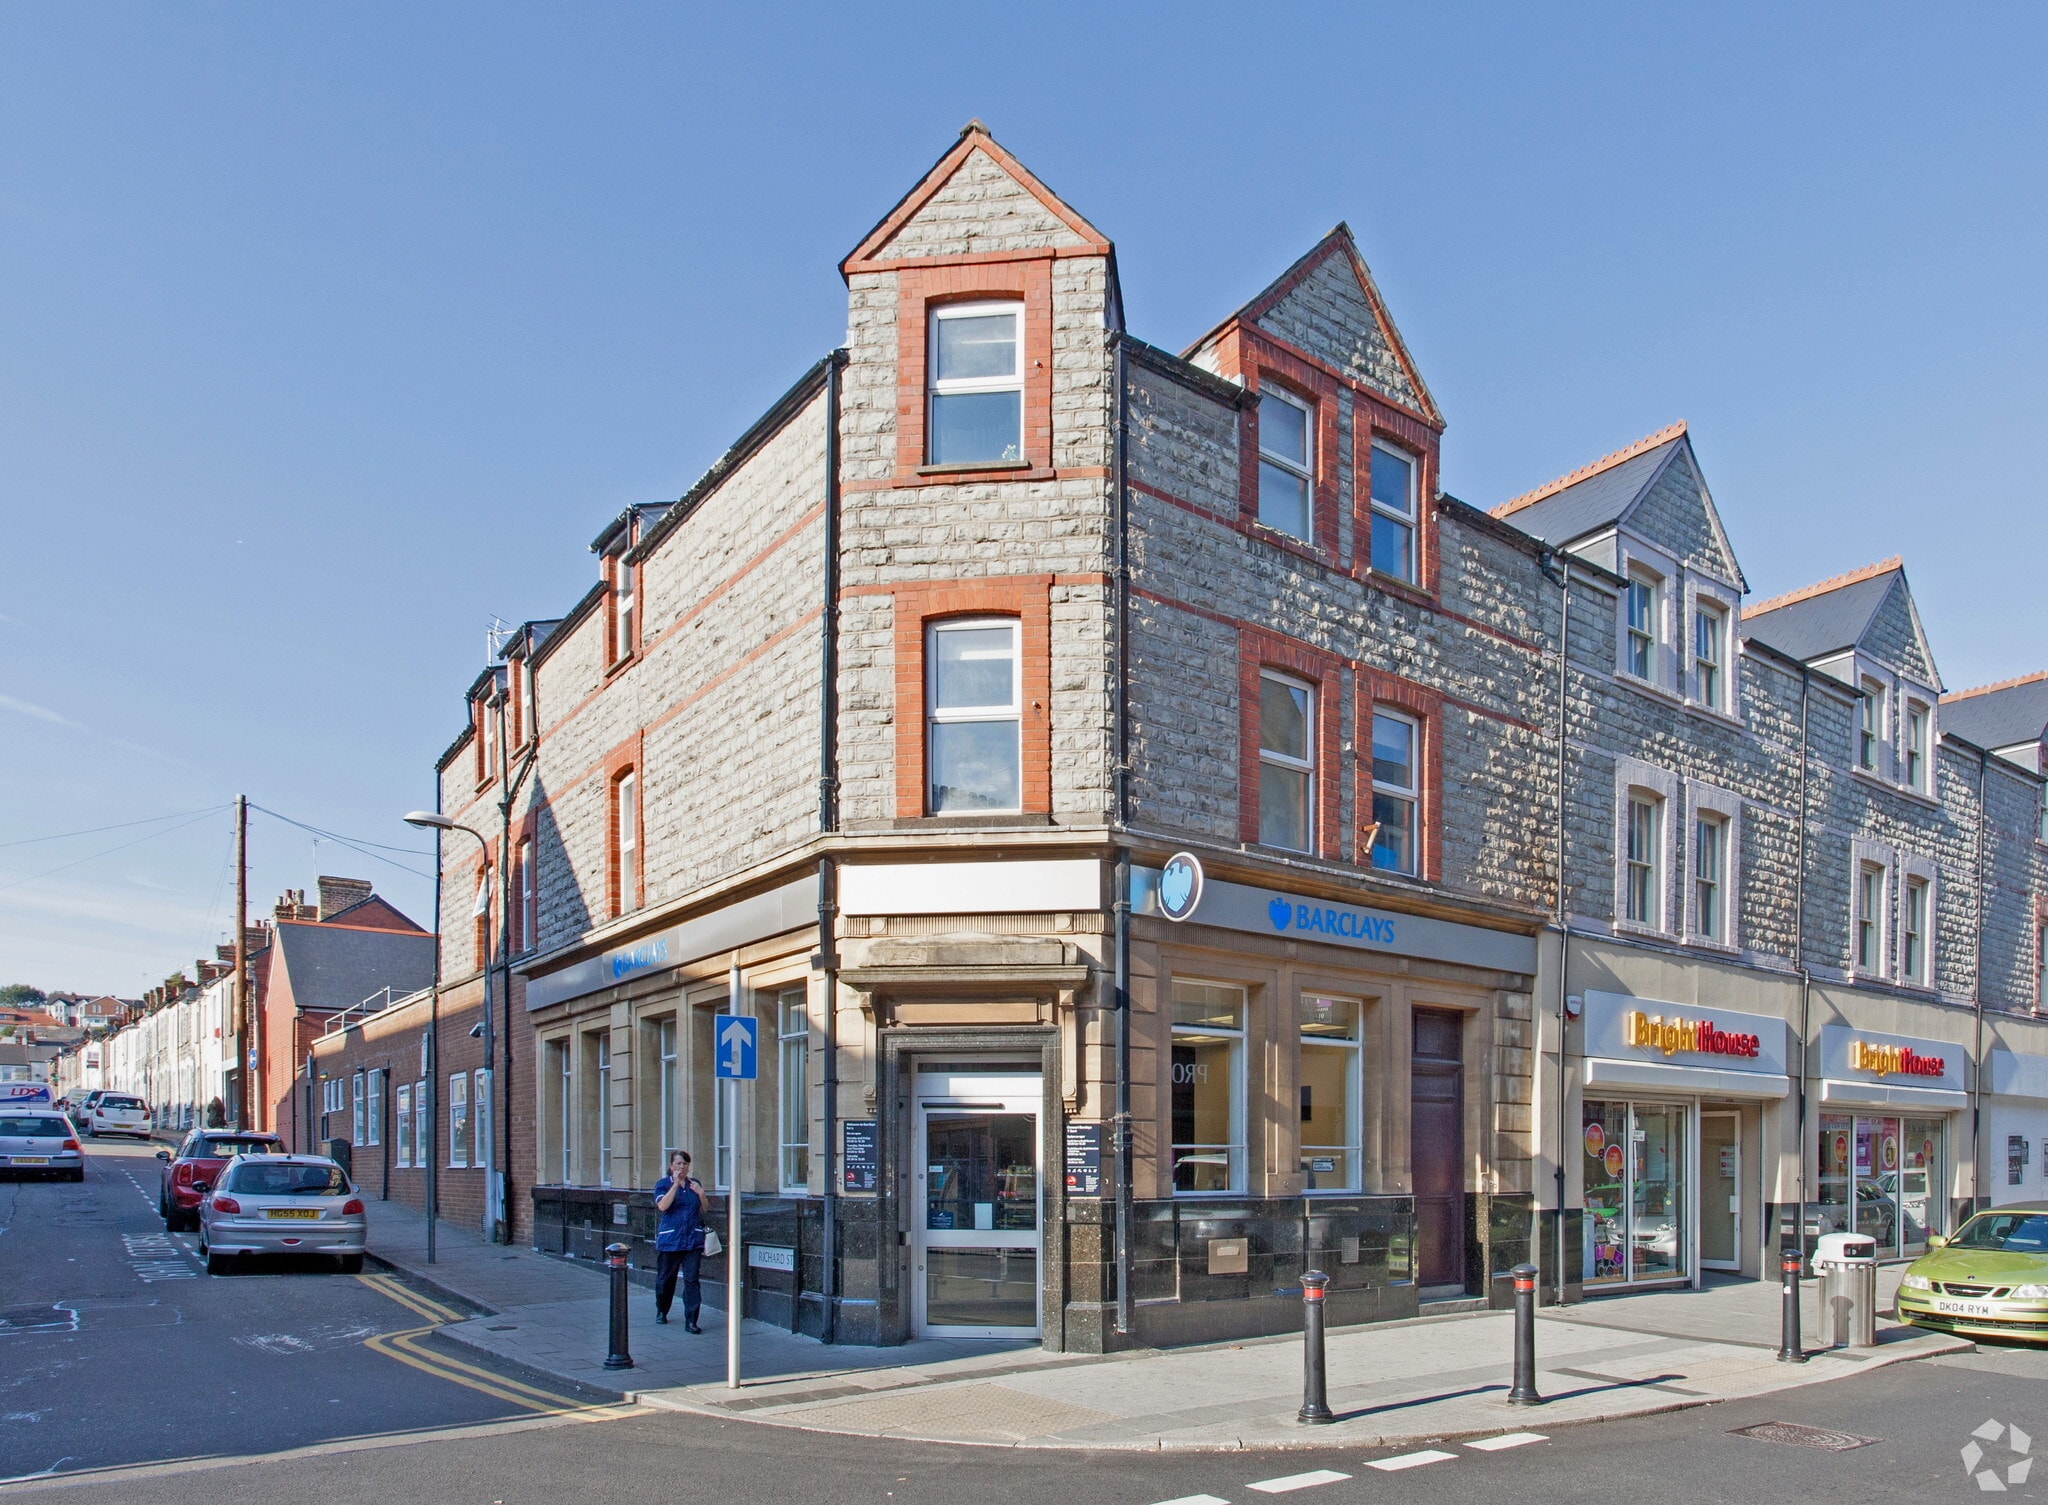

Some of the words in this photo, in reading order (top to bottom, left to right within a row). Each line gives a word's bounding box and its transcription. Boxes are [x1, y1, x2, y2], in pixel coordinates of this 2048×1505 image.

[1296, 904, 1395, 944] BARCLAYS
[1629, 1011, 1760, 1057] BrightHouse
[1853, 1041, 1945, 1077] BrightHouse
[11, 1088, 40, 1096] LDS
[271, 1210, 295, 1218] HG55
[758, 1251, 784, 1265] RICHARD
[1939, 1301, 1964, 1312] DK04
[1968, 1304, 1989, 1315] RYM
